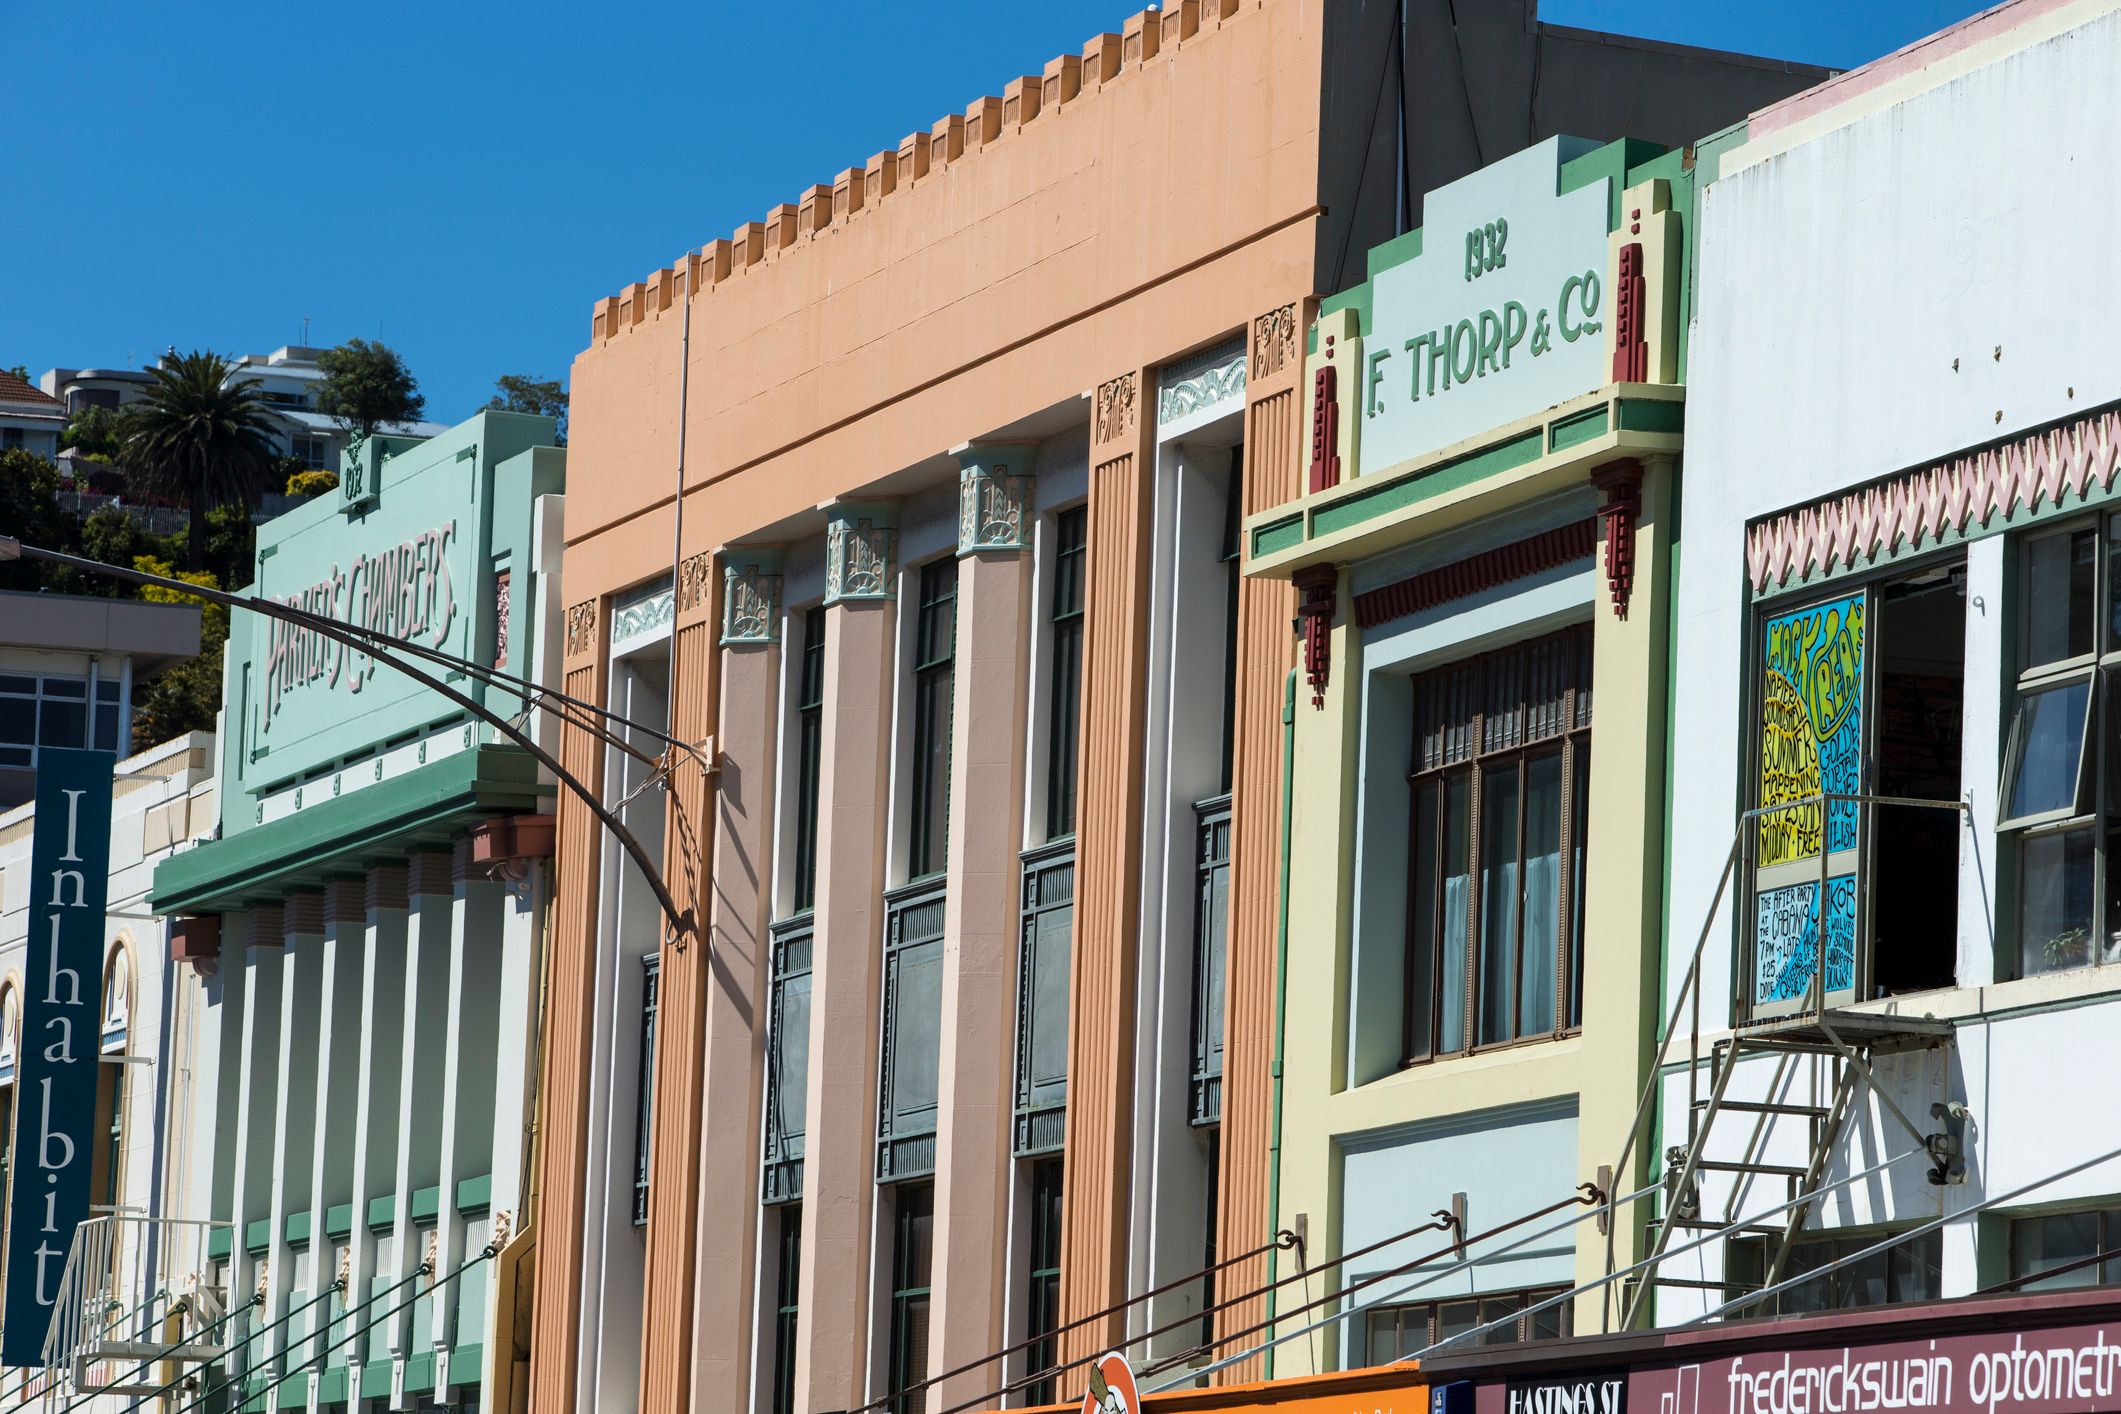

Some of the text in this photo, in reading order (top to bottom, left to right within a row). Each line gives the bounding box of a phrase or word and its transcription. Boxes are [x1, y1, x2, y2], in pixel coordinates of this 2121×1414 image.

[1464, 217, 1508, 282] 1932
[1367, 347, 1392, 418] F.
[1405, 299, 1527, 402] THORP
[1530, 308, 1552, 357] &
[1763, 718, 1818, 775] SUMMER
[1760, 886, 1815, 912] THE AFTER PARTY
[1760, 926, 1769, 938] THE
[1761, 915, 1768, 925] AT
[1762, 960, 1776, 979] $25
[33, 789, 88, 1306] Inhabit
[1509, 1381, 1623, 1414] HASTINGS ST
